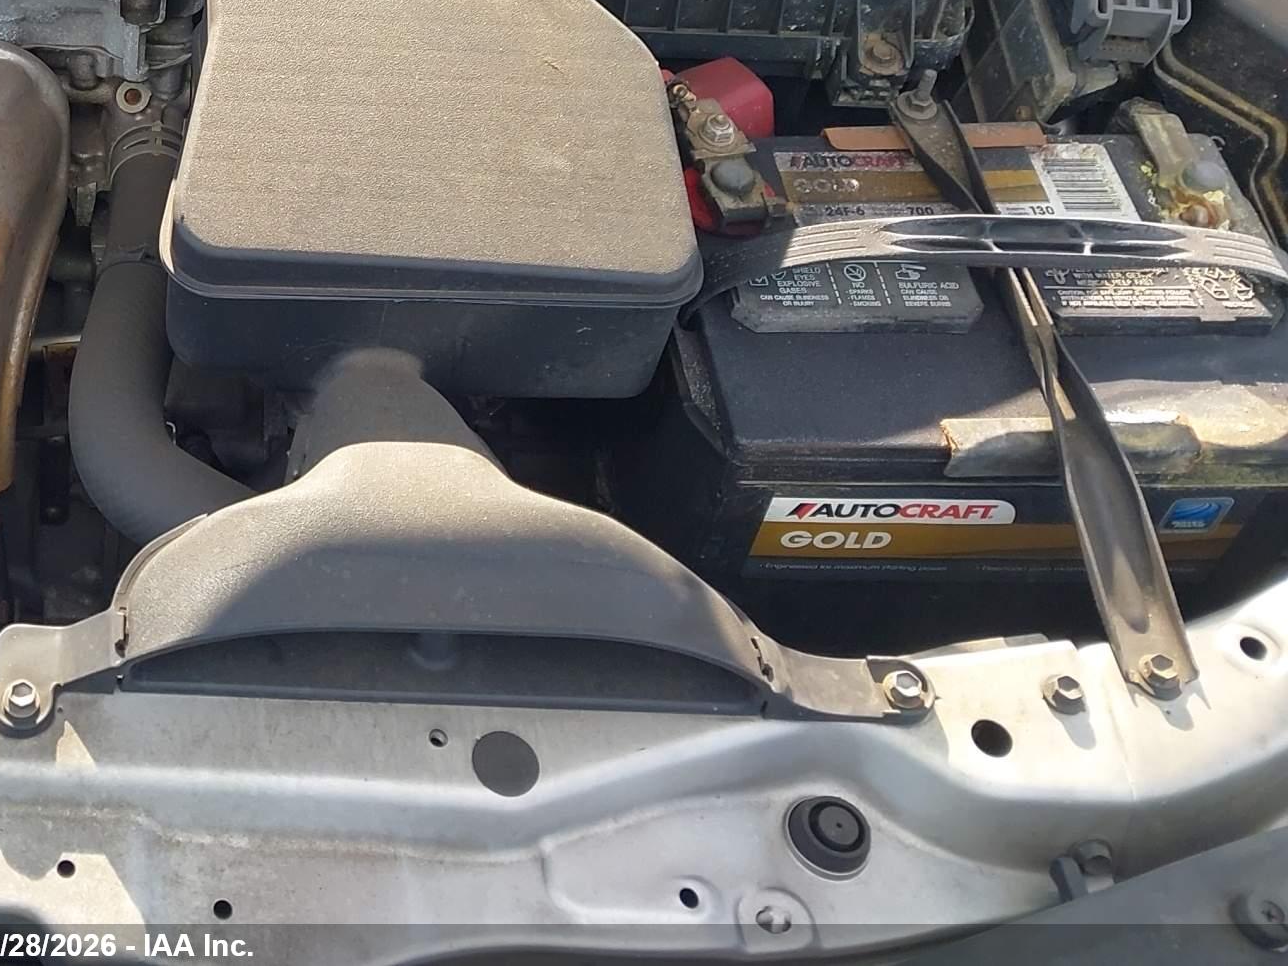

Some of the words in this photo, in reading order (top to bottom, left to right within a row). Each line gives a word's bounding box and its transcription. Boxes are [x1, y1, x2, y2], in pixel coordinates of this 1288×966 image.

[907, 207, 934, 216] 700
[1029, 205, 1055, 216] 130
[809, 502, 999, 519] AUTOCRAFT
[780, 530, 892, 549] GOLD
